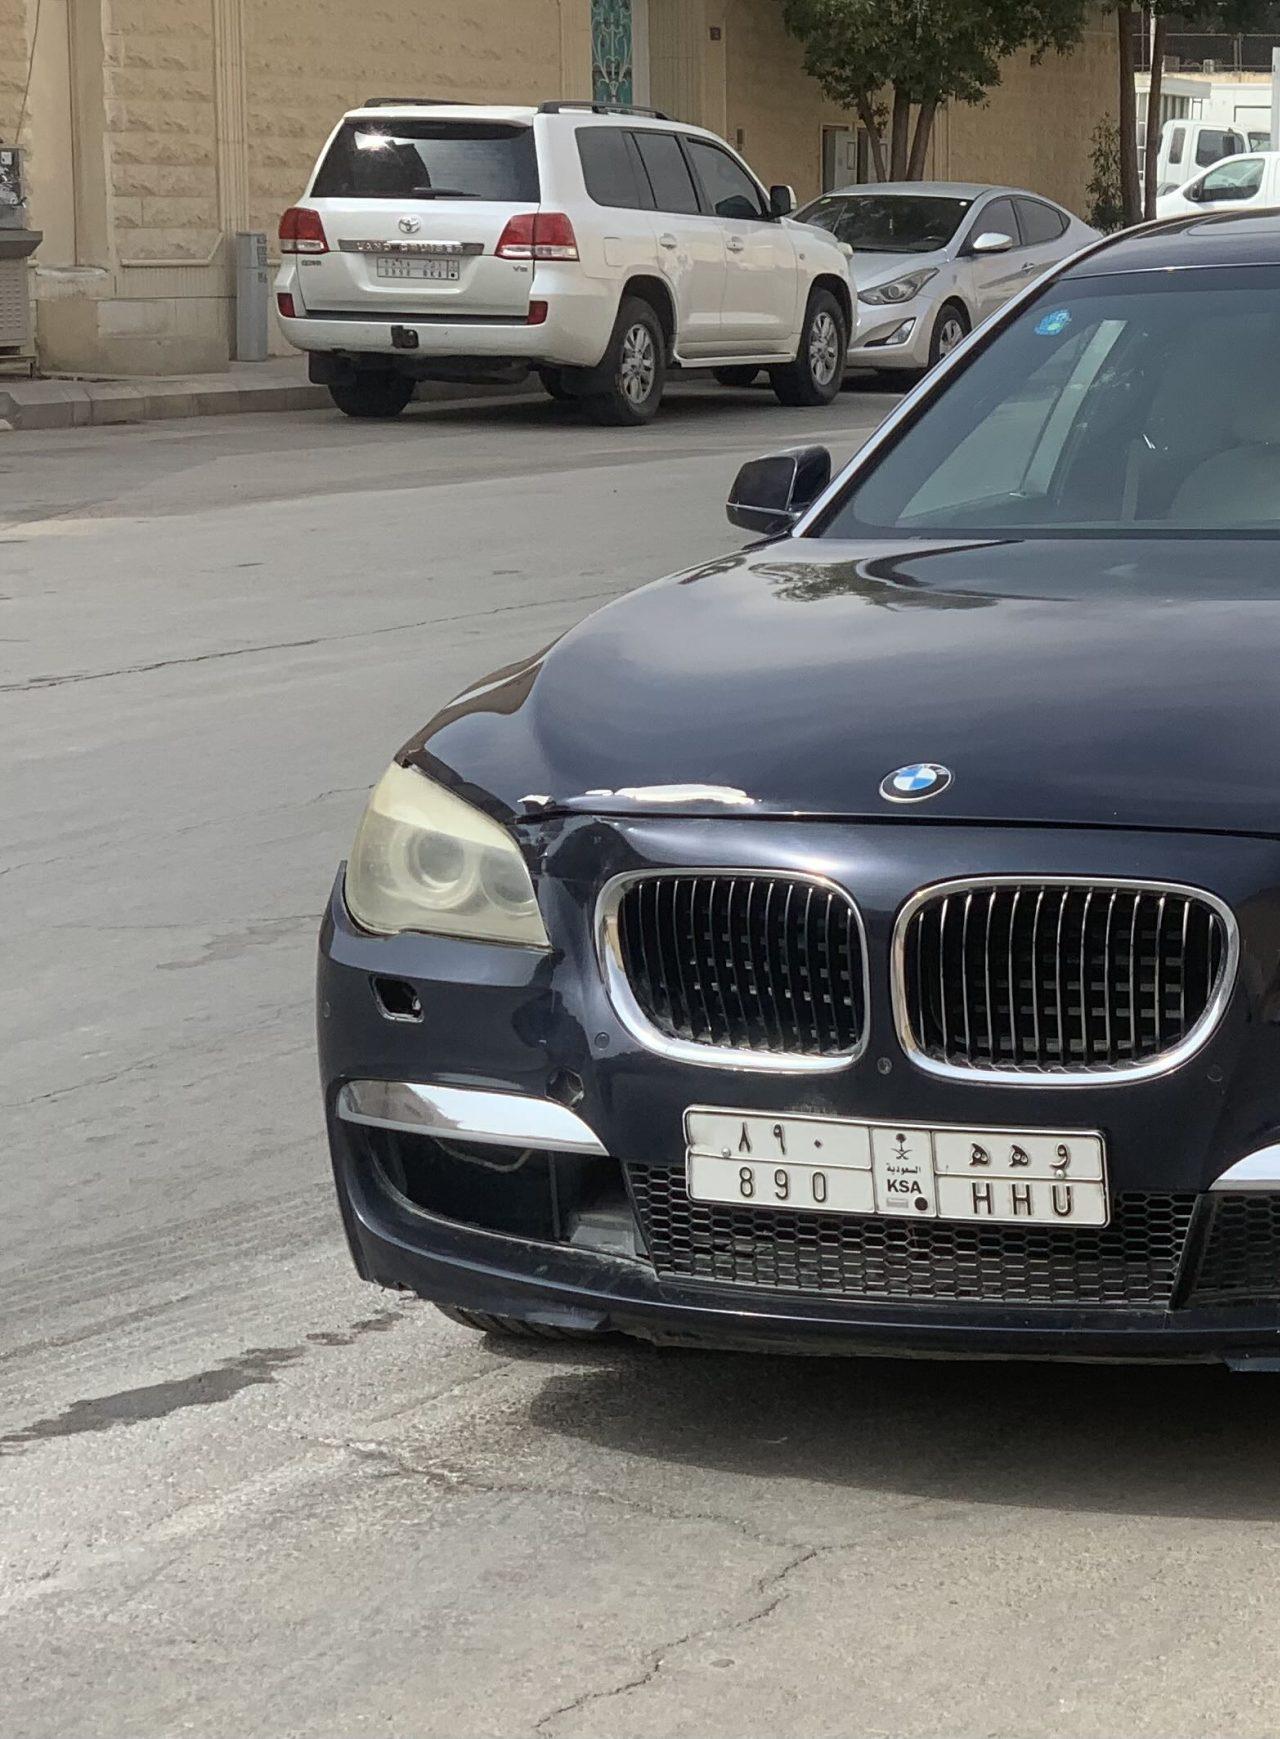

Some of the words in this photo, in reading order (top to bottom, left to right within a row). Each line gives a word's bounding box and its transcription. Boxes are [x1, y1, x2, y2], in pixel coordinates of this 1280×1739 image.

[356, 242, 391, 251] LAND
[886, 1163, 922, 1176] السعودية
[887, 1178, 922, 1195] KSA
